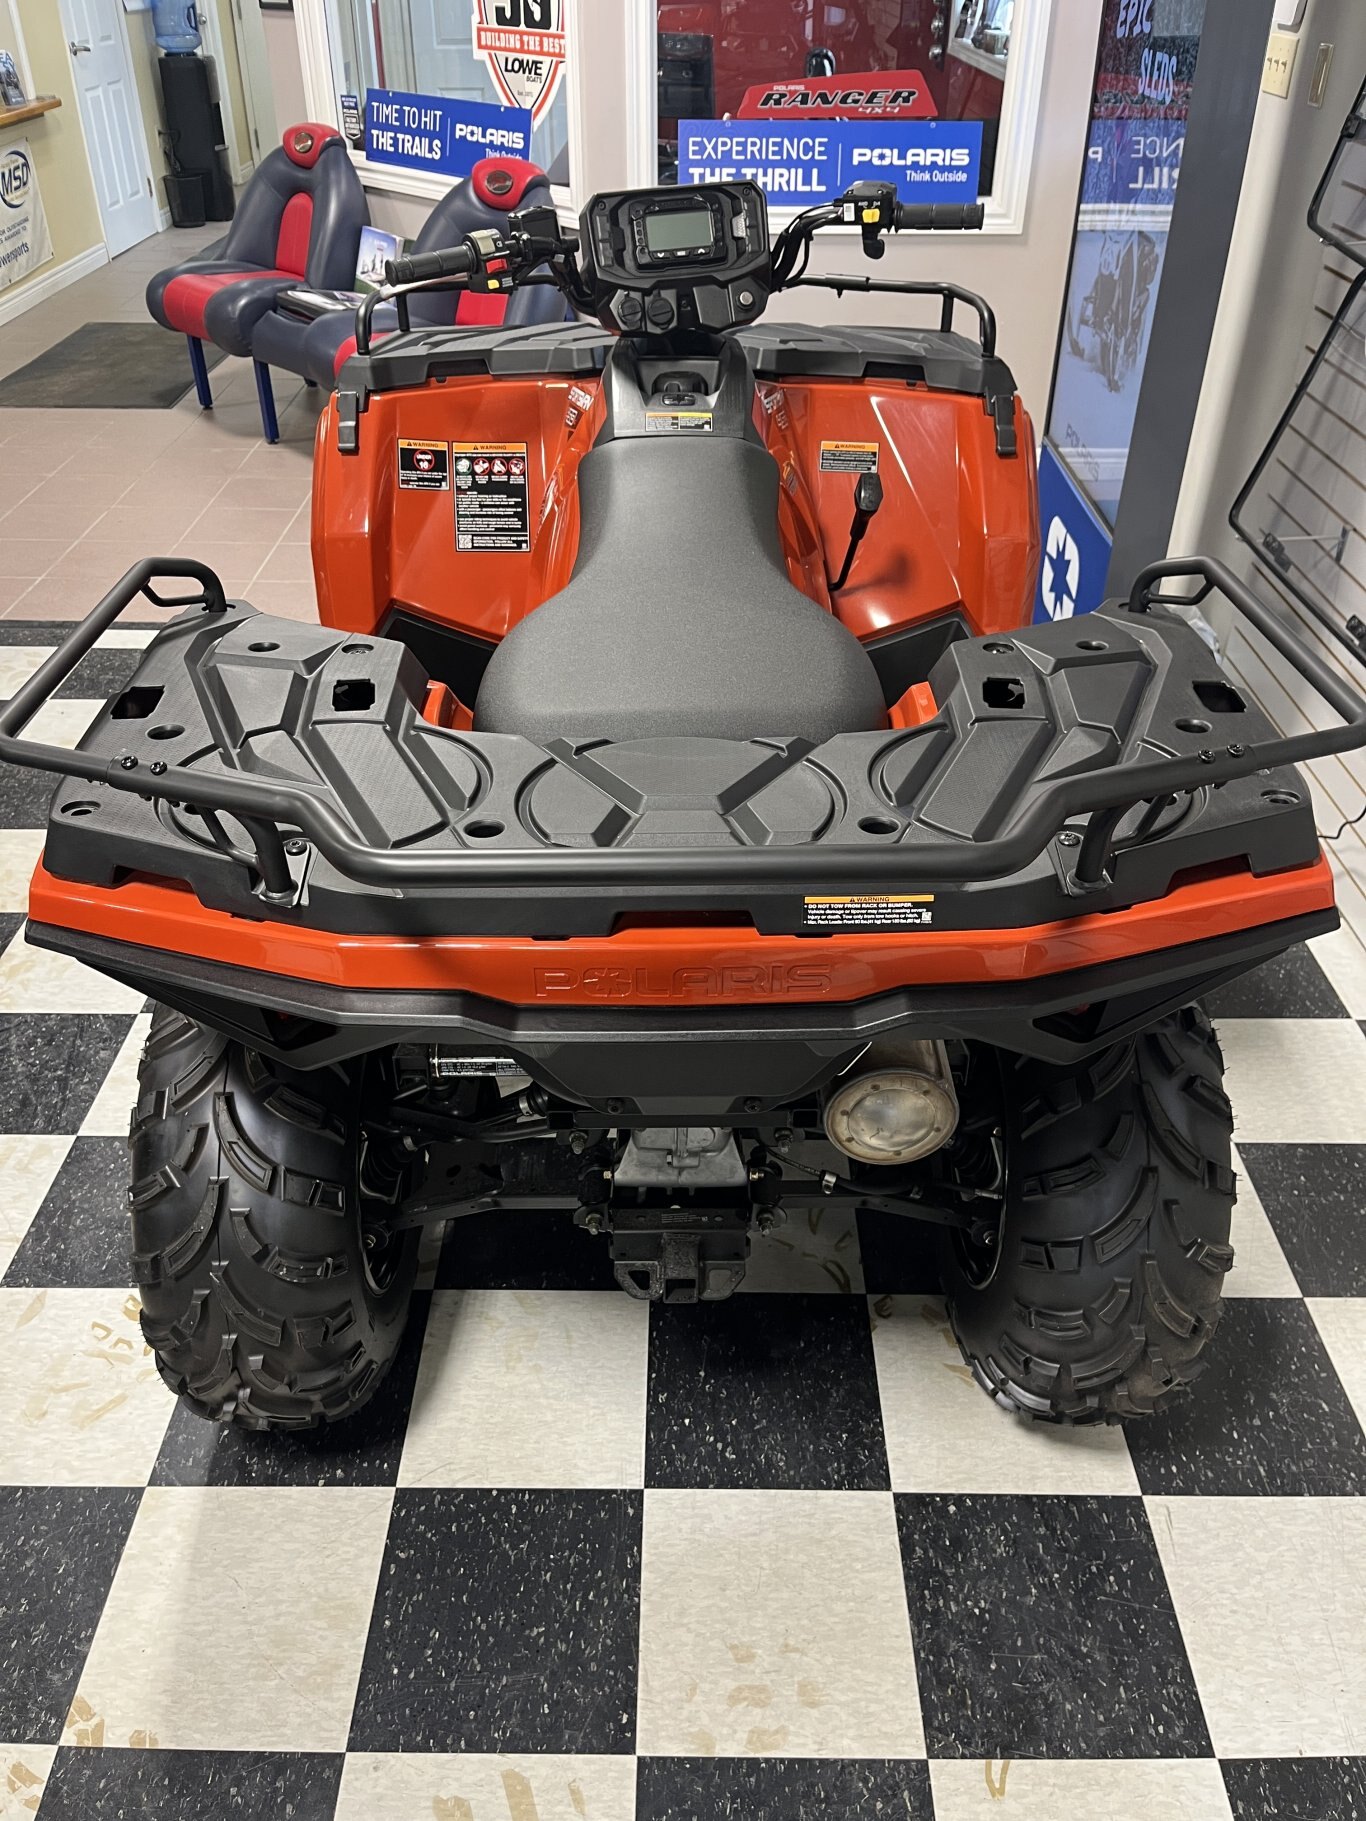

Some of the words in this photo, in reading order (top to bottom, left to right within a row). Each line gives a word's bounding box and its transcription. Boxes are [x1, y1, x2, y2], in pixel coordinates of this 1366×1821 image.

[480, 31, 520, 49] BUILDING
[523, 35, 541, 51] THE
[543, 37, 565, 54] BEST
[504, 56, 543, 76] LOWE
[1138, 48, 1178, 105] SLEDS
[757, 89, 918, 108] RANGER
[371, 101, 400, 127] TIME
[403, 106, 418, 128] TO
[421, 110, 442, 132] HIT
[371, 129, 395, 152] THE
[397, 133, 441, 160] TRAILS
[455, 123, 524, 150] POLARIS
[688, 137, 828, 160] EXPERIENCE
[852, 148, 970, 166] POLARIS
[688, 168, 736, 184] THE
[741, 168, 827, 192] THRILL
[906, 170, 930, 182] Think
[932, 170, 967, 183] Outside
[533, 963, 833, 998] POLARIS
